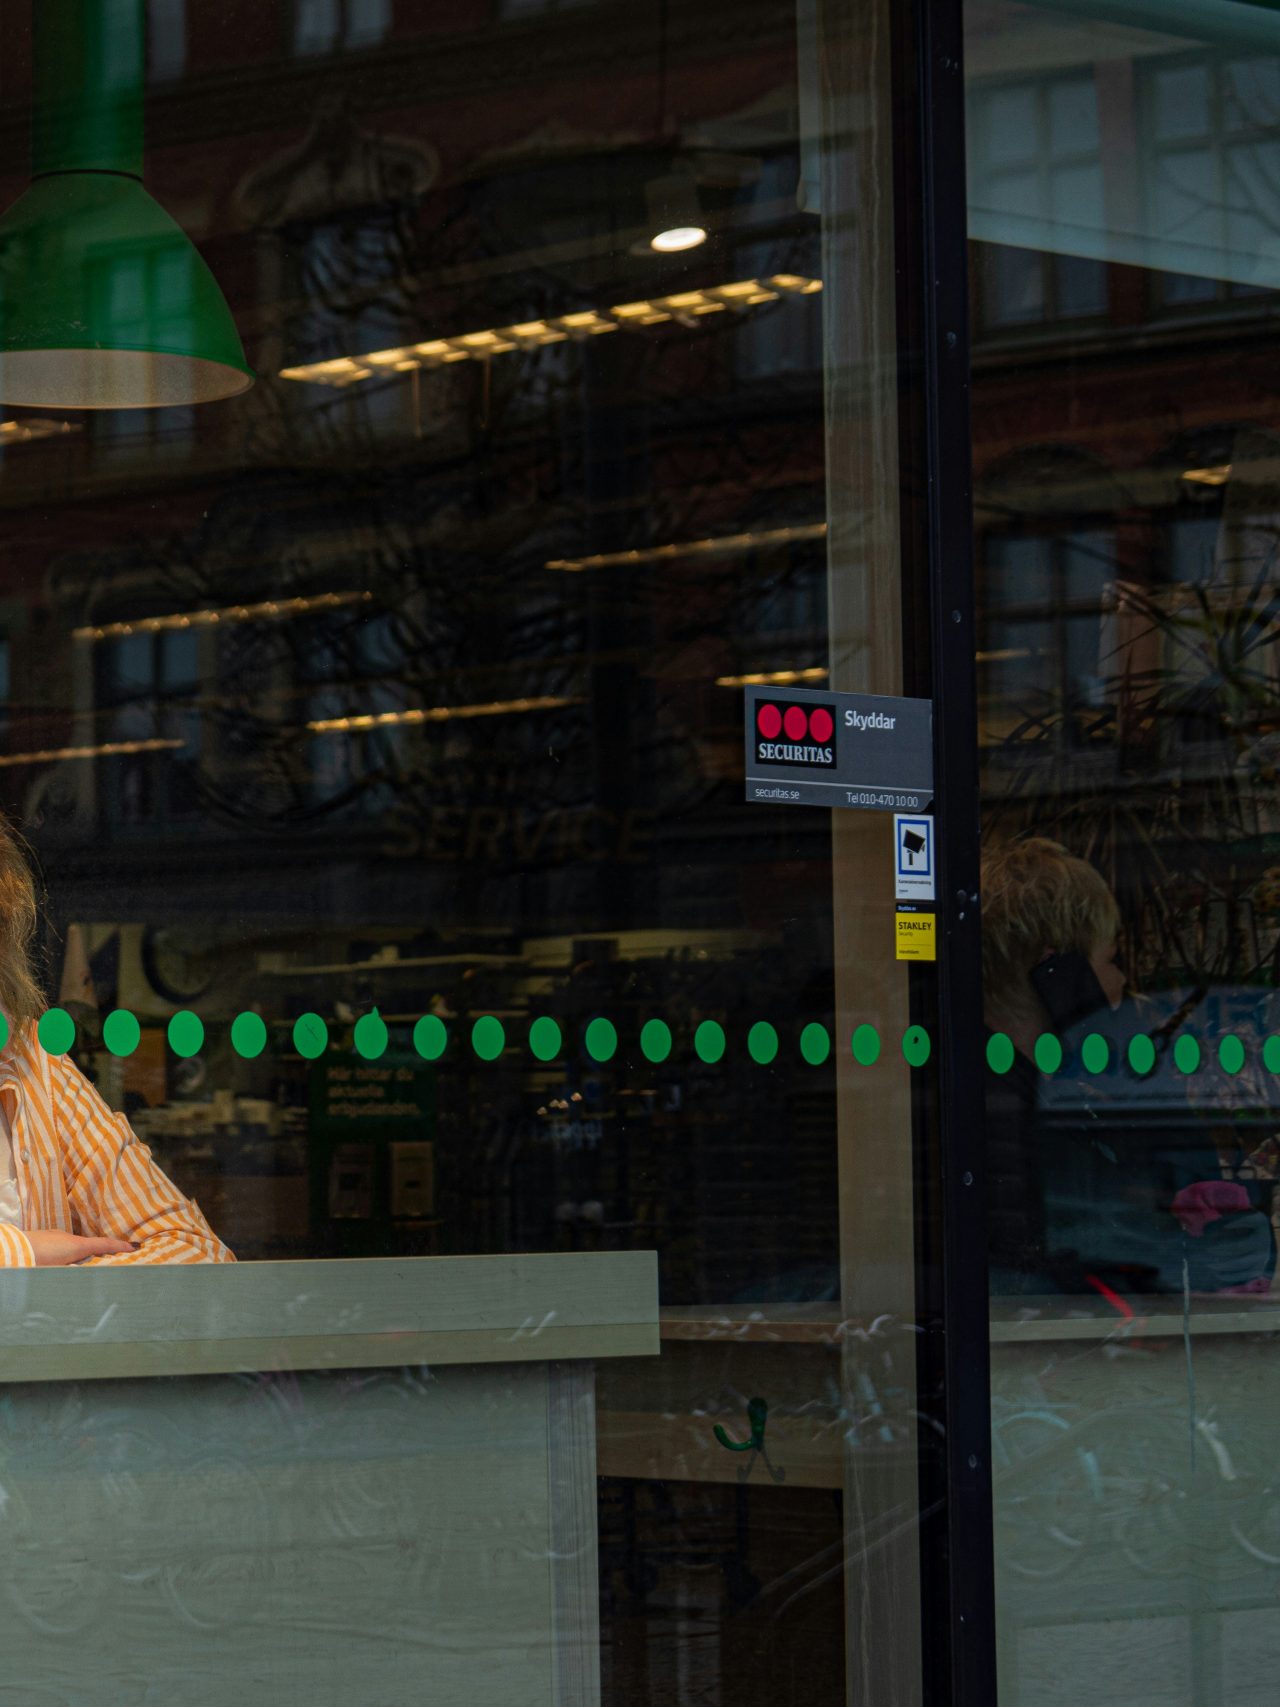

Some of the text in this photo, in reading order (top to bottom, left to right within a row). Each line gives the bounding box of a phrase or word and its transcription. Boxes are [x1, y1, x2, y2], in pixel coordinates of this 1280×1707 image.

[845, 710, 896, 730] Skyddar
[758, 743, 833, 763] SECURITAS
[755, 787, 800, 799] securitas.se
[846, 792, 919, 808] Tel 010-470 10 00
[381, 802, 657, 864] SERVICE
[898, 921, 932, 931] STANLEY
